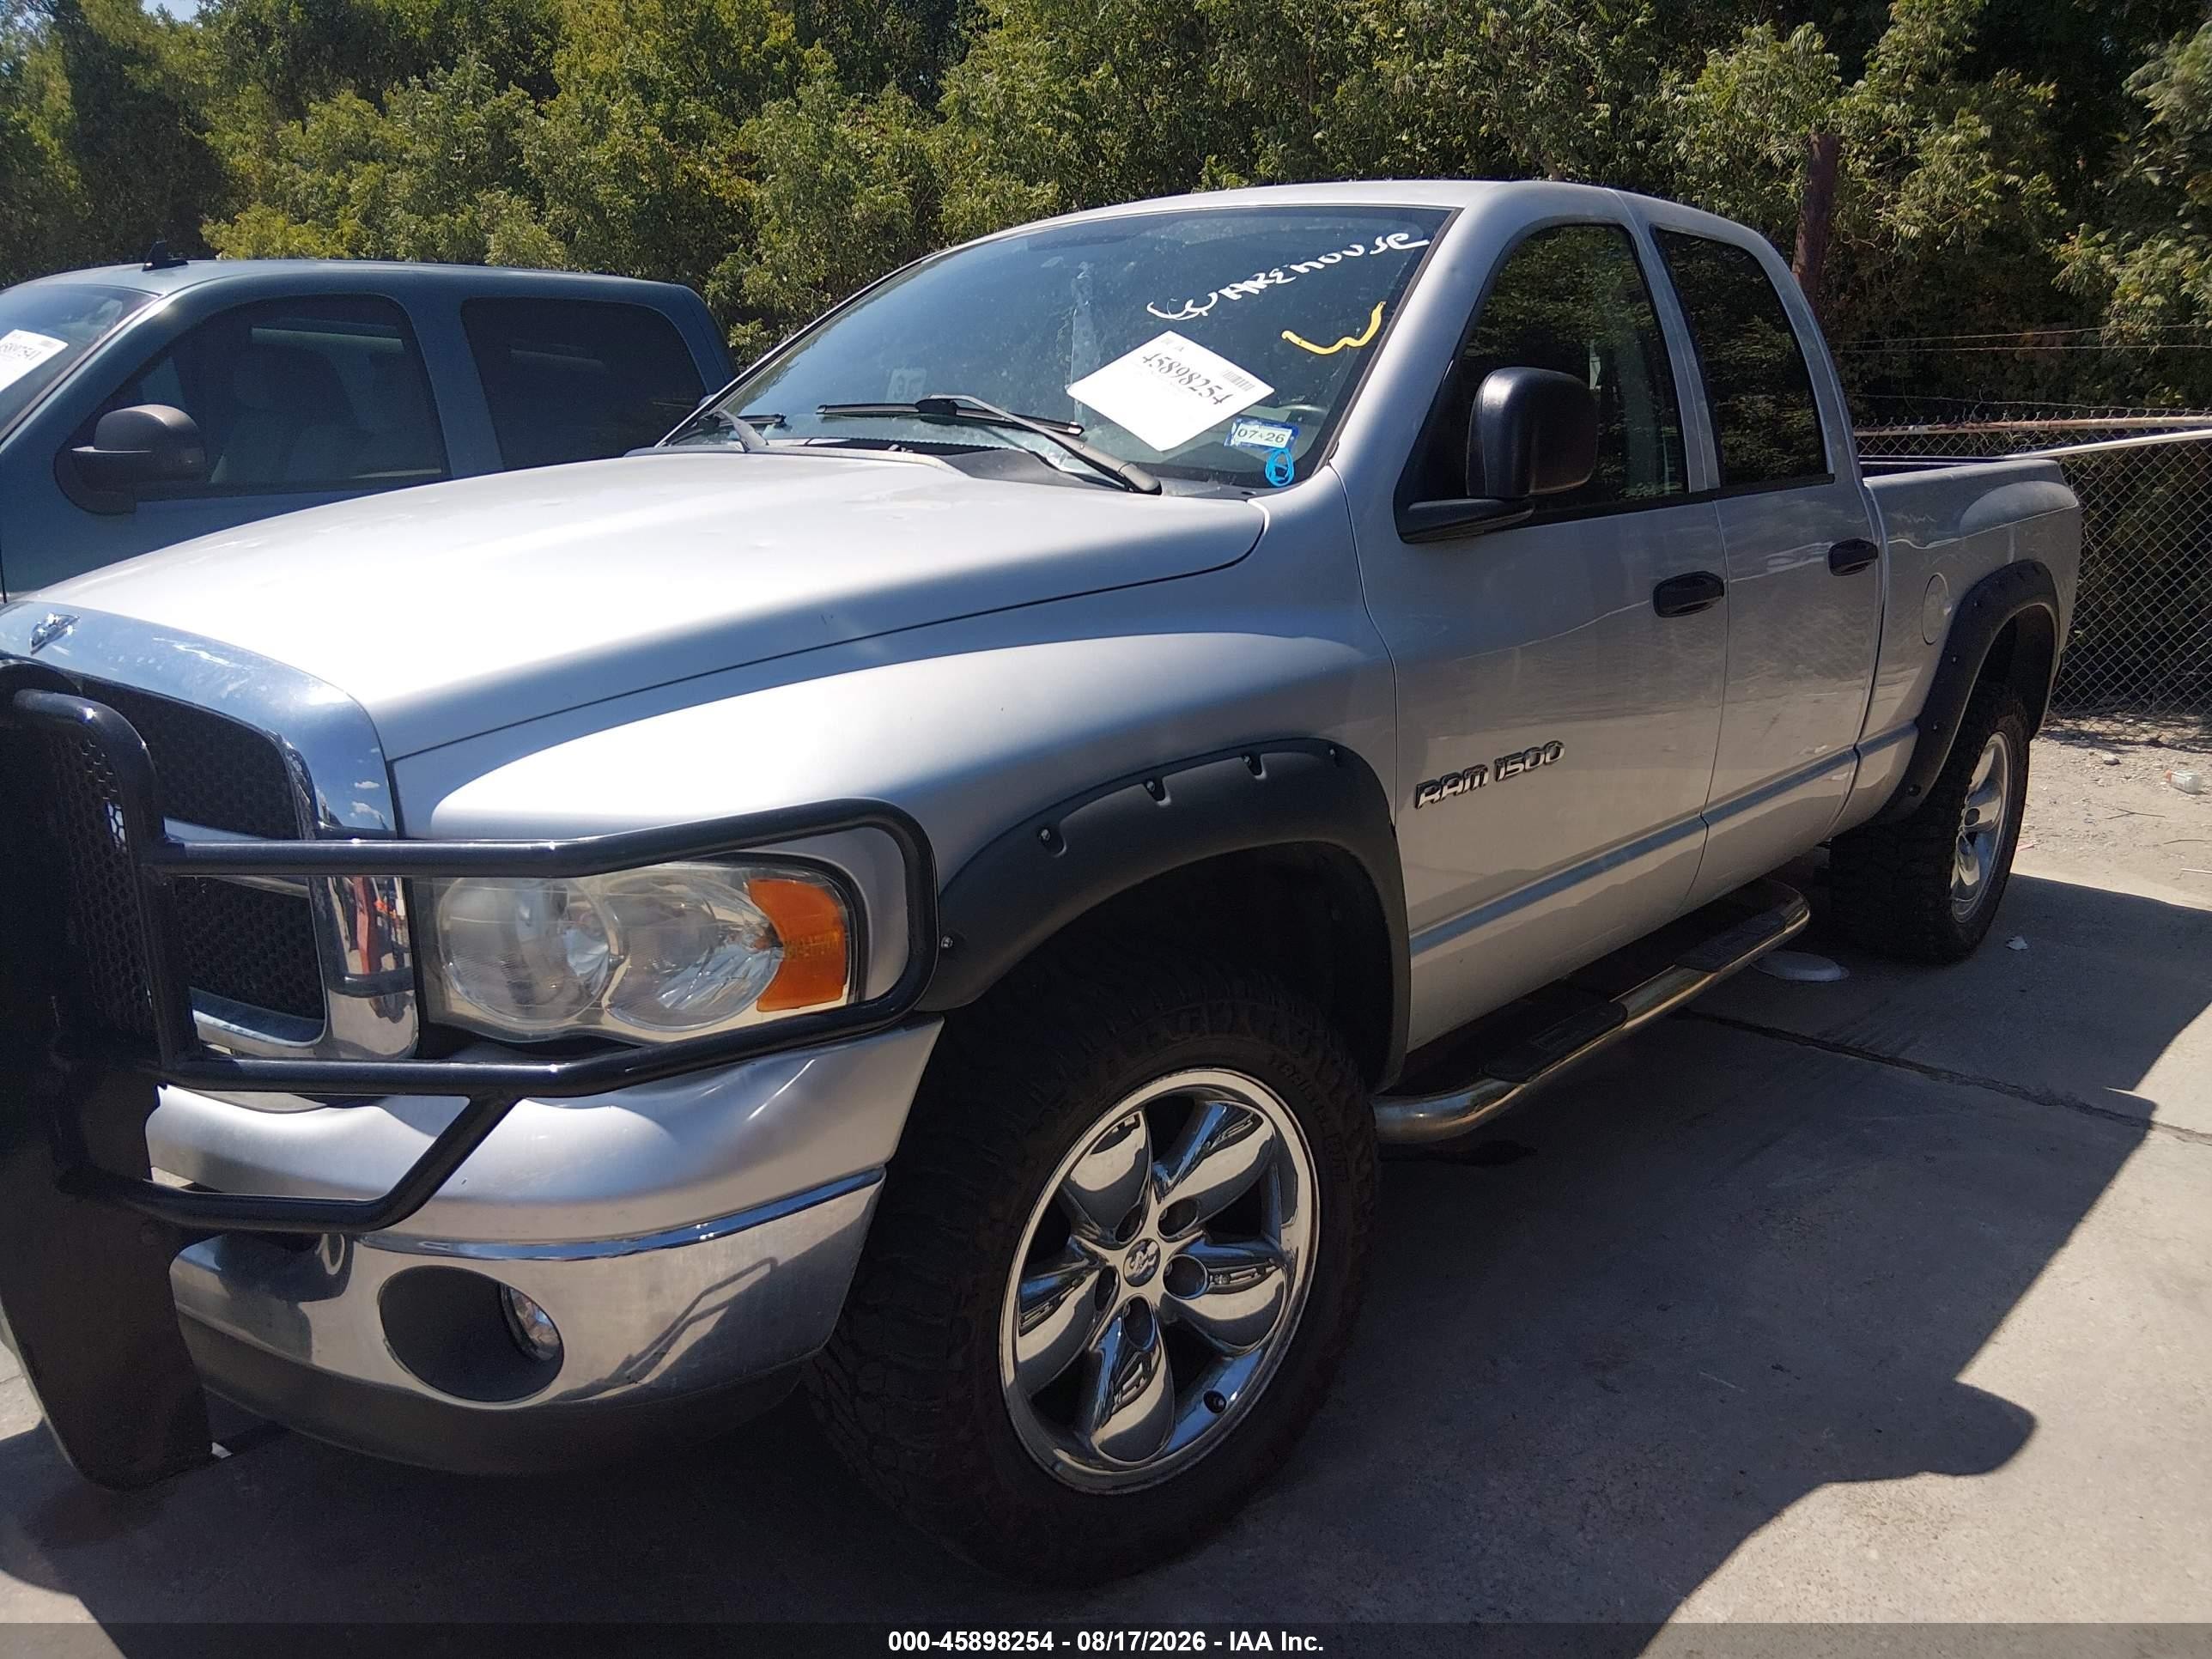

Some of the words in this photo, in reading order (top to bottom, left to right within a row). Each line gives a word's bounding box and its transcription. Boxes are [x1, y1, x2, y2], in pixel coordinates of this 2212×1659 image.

[1142, 352, 1234, 404] 45898254
[1415, 763, 1489, 809] RAM
[1494, 740, 1565, 781] 1500
